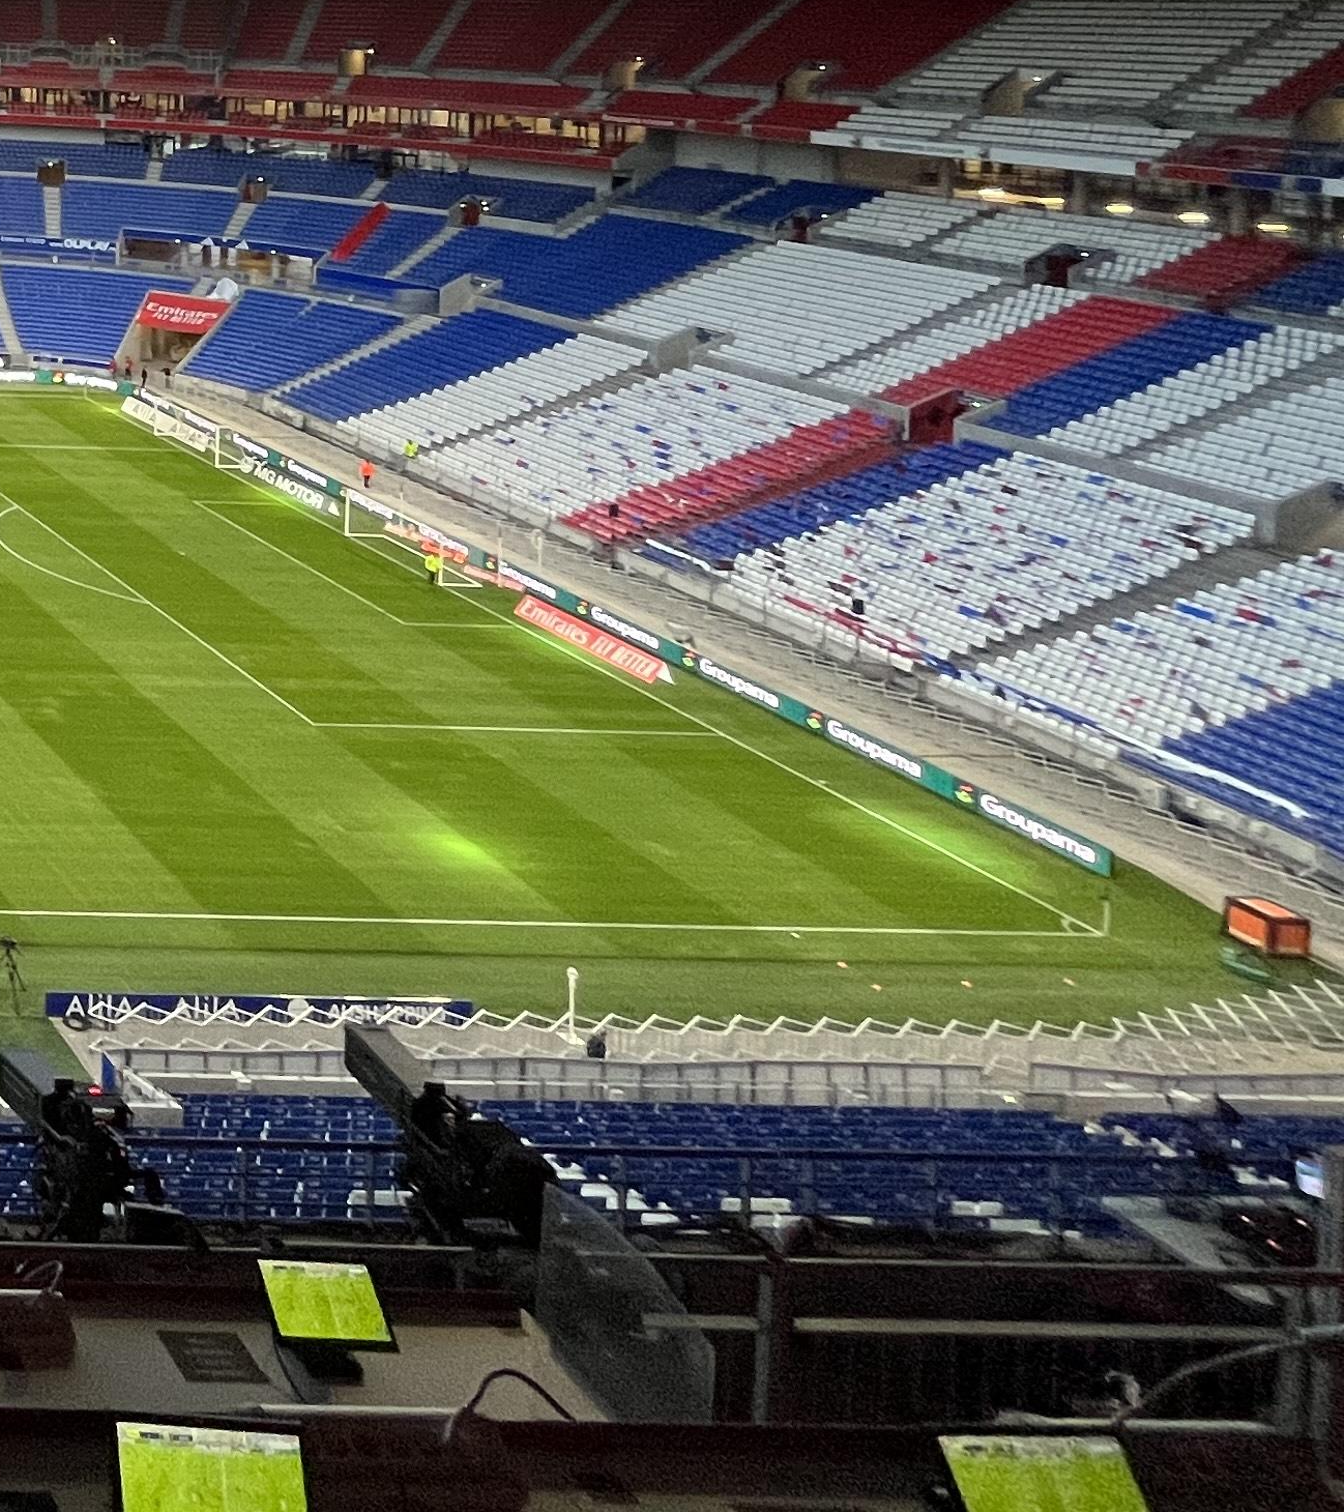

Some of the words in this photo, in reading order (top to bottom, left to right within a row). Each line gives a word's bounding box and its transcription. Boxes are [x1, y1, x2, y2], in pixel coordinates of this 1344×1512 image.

[520, 598, 590, 646] Emirates
[590, 606, 660, 650] Groupama
[698, 656, 780, 710] Groupama
[826, 718, 922, 780] Groupama
[980, 791, 1097, 866] Groupama
